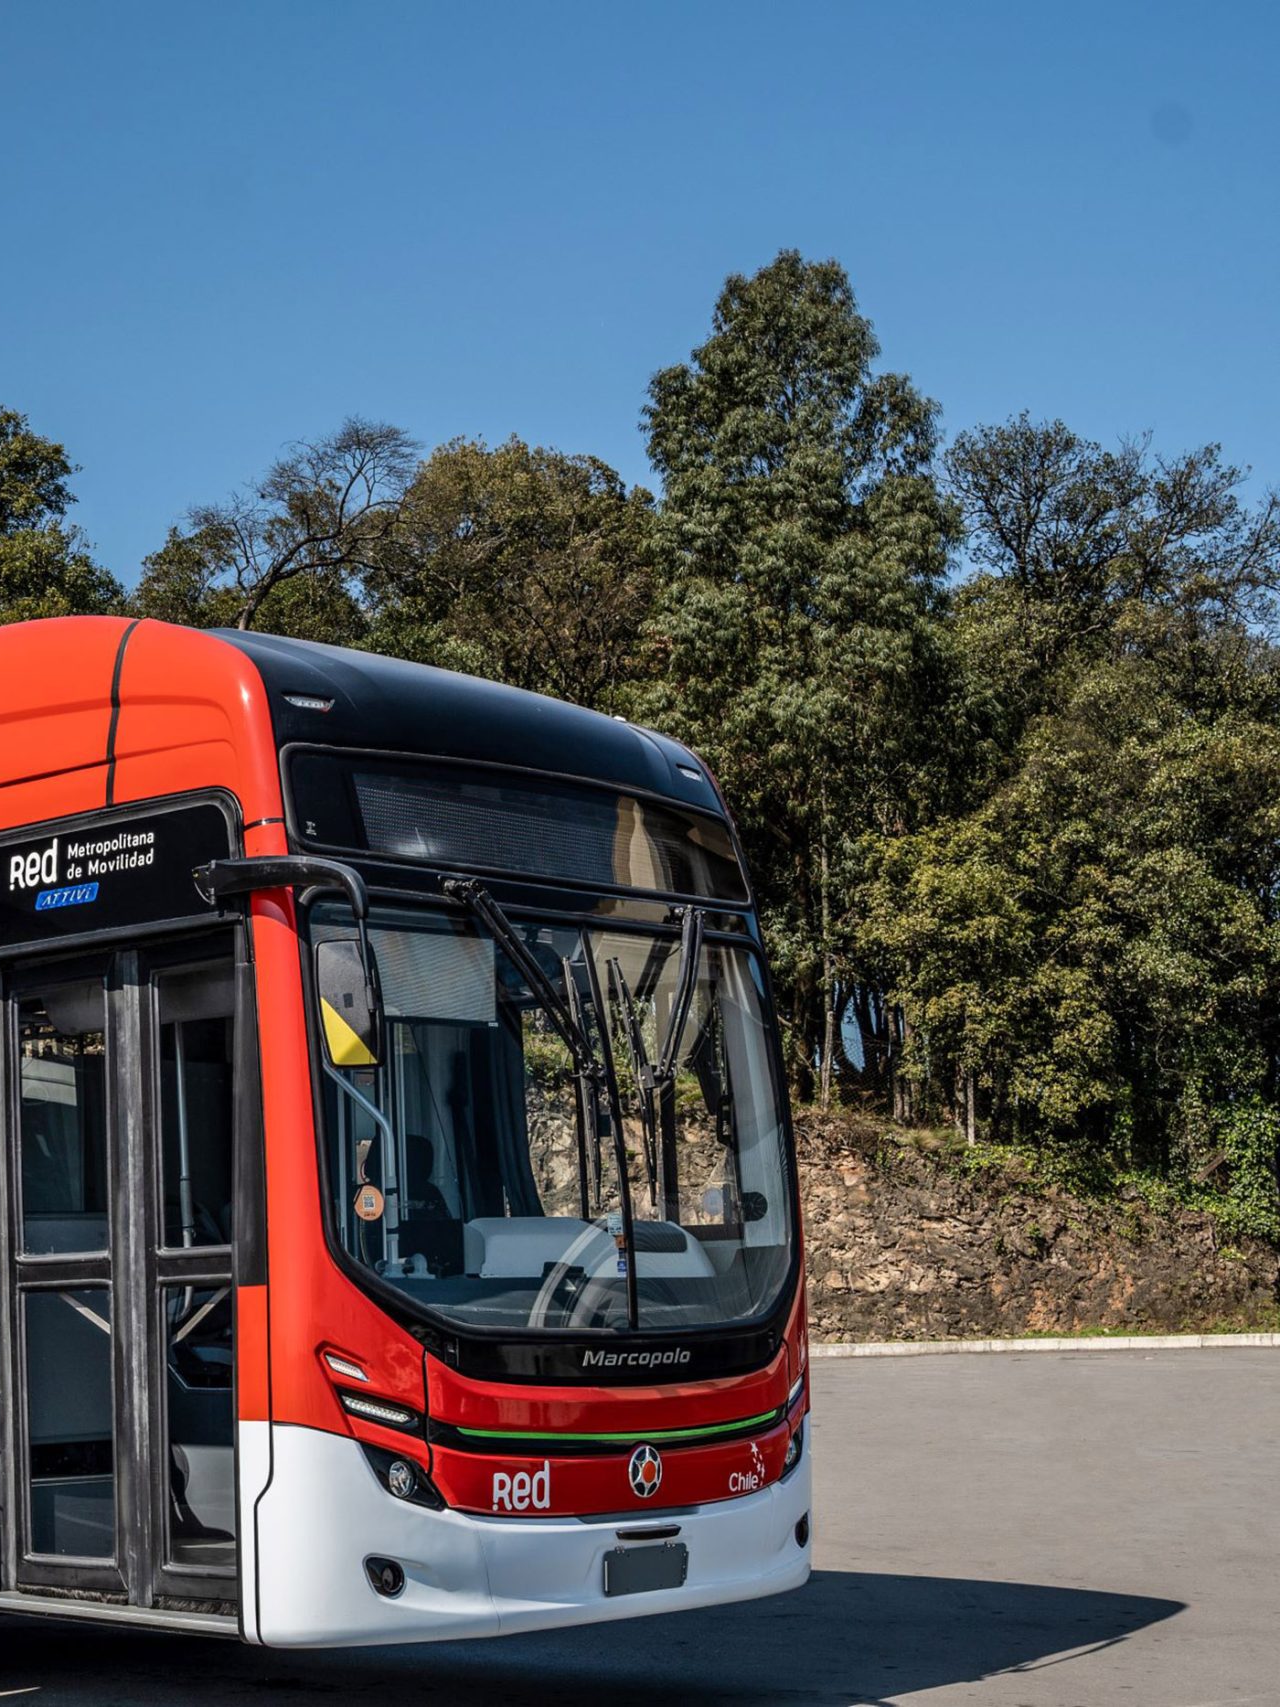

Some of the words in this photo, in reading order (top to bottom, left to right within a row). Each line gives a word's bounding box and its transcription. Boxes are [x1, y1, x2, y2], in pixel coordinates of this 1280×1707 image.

[67, 832, 155, 860] Metropolitana
[9, 838, 58, 891] Red
[66, 864, 82, 880] de
[87, 848, 154, 876] Movilidad
[582, 1347, 691, 1368] Marcopolo
[492, 1459, 550, 1511] Red
[729, 1472, 758, 1493] Chile
